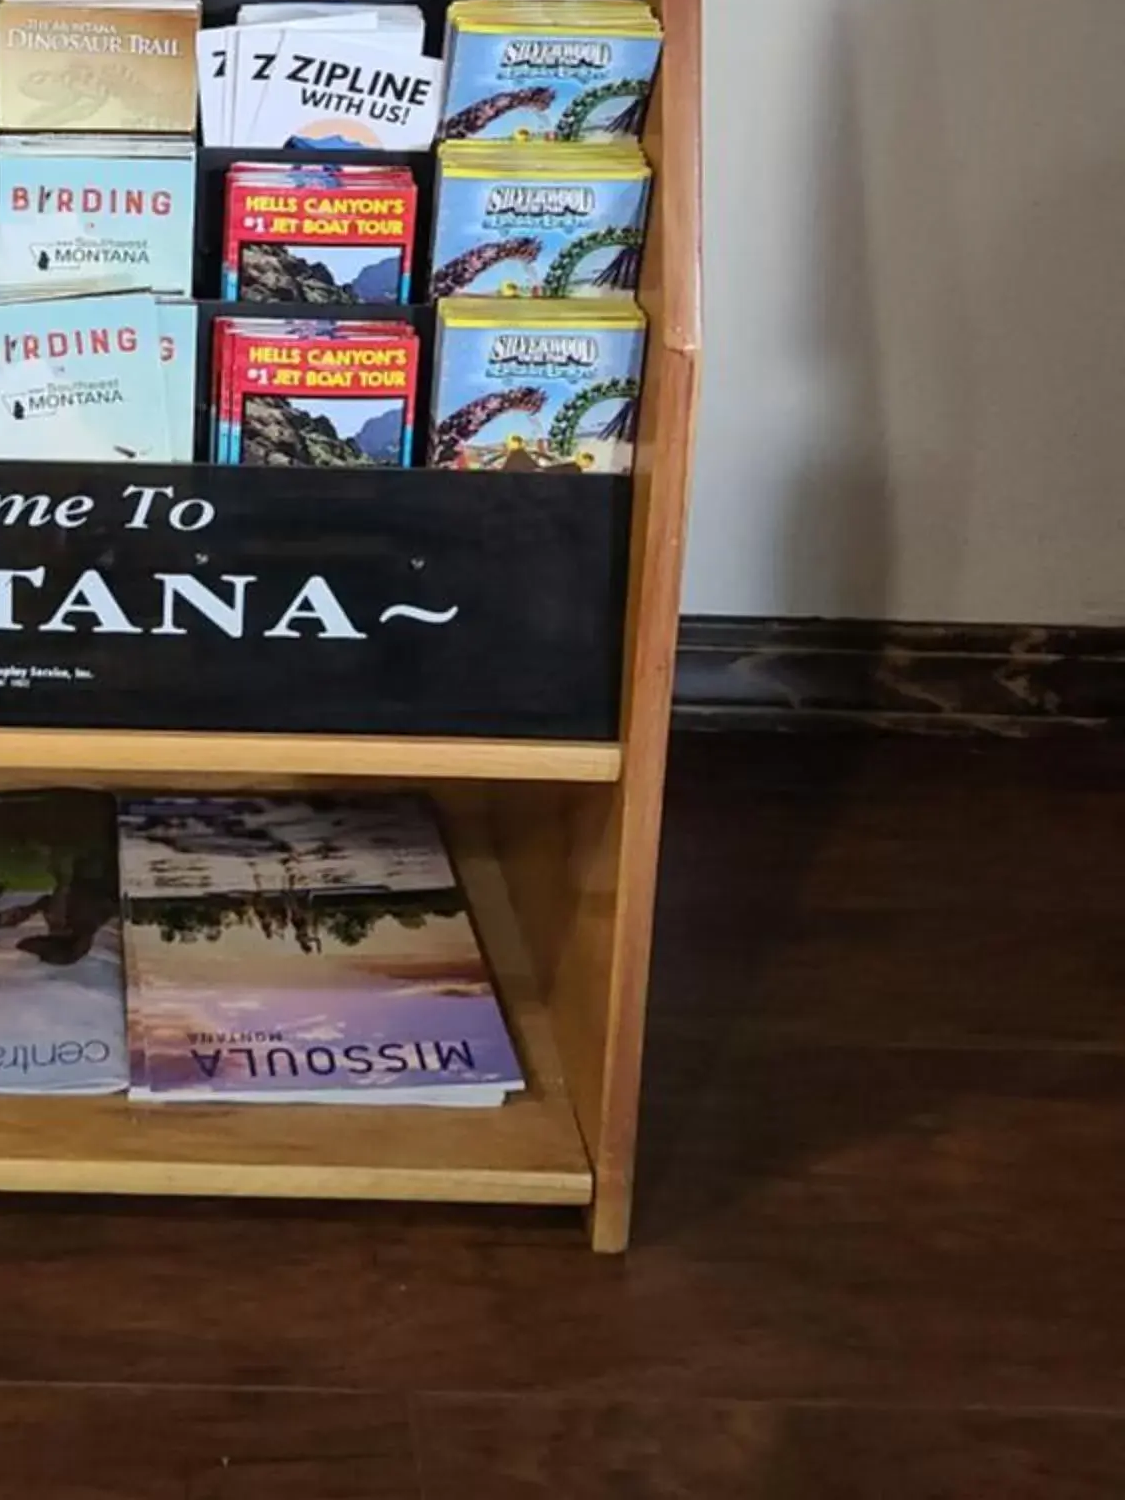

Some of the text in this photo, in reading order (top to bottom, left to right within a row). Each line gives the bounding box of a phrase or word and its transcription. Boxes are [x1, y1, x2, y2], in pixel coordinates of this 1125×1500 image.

[7, 30, 183, 56] DINOSAUR TRAIL
[286, 55, 431, 105] ZIPLINE
[299, 88, 410, 125] WITH US!
[11, 184, 173, 215] BIRDING
[245, 195, 404, 215] HELLS CANYON'S
[244, 216, 404, 234] #1 JET BOAT TOUR
[54, 248, 151, 264] MONTANA
[249, 347, 407, 366] HELLS CANYON'S
[247, 369, 407, 386] #1 JET BOAT TOUR
[27, 389, 124, 409] MONTANA
[122, 484, 215, 532] To
[29, 667, 72, 679] Service,
[75, 668, 95, 678] Inc.
[187, 1030, 283, 1044] MONTANA
[191, 1039, 475, 1078] MISSOULA
